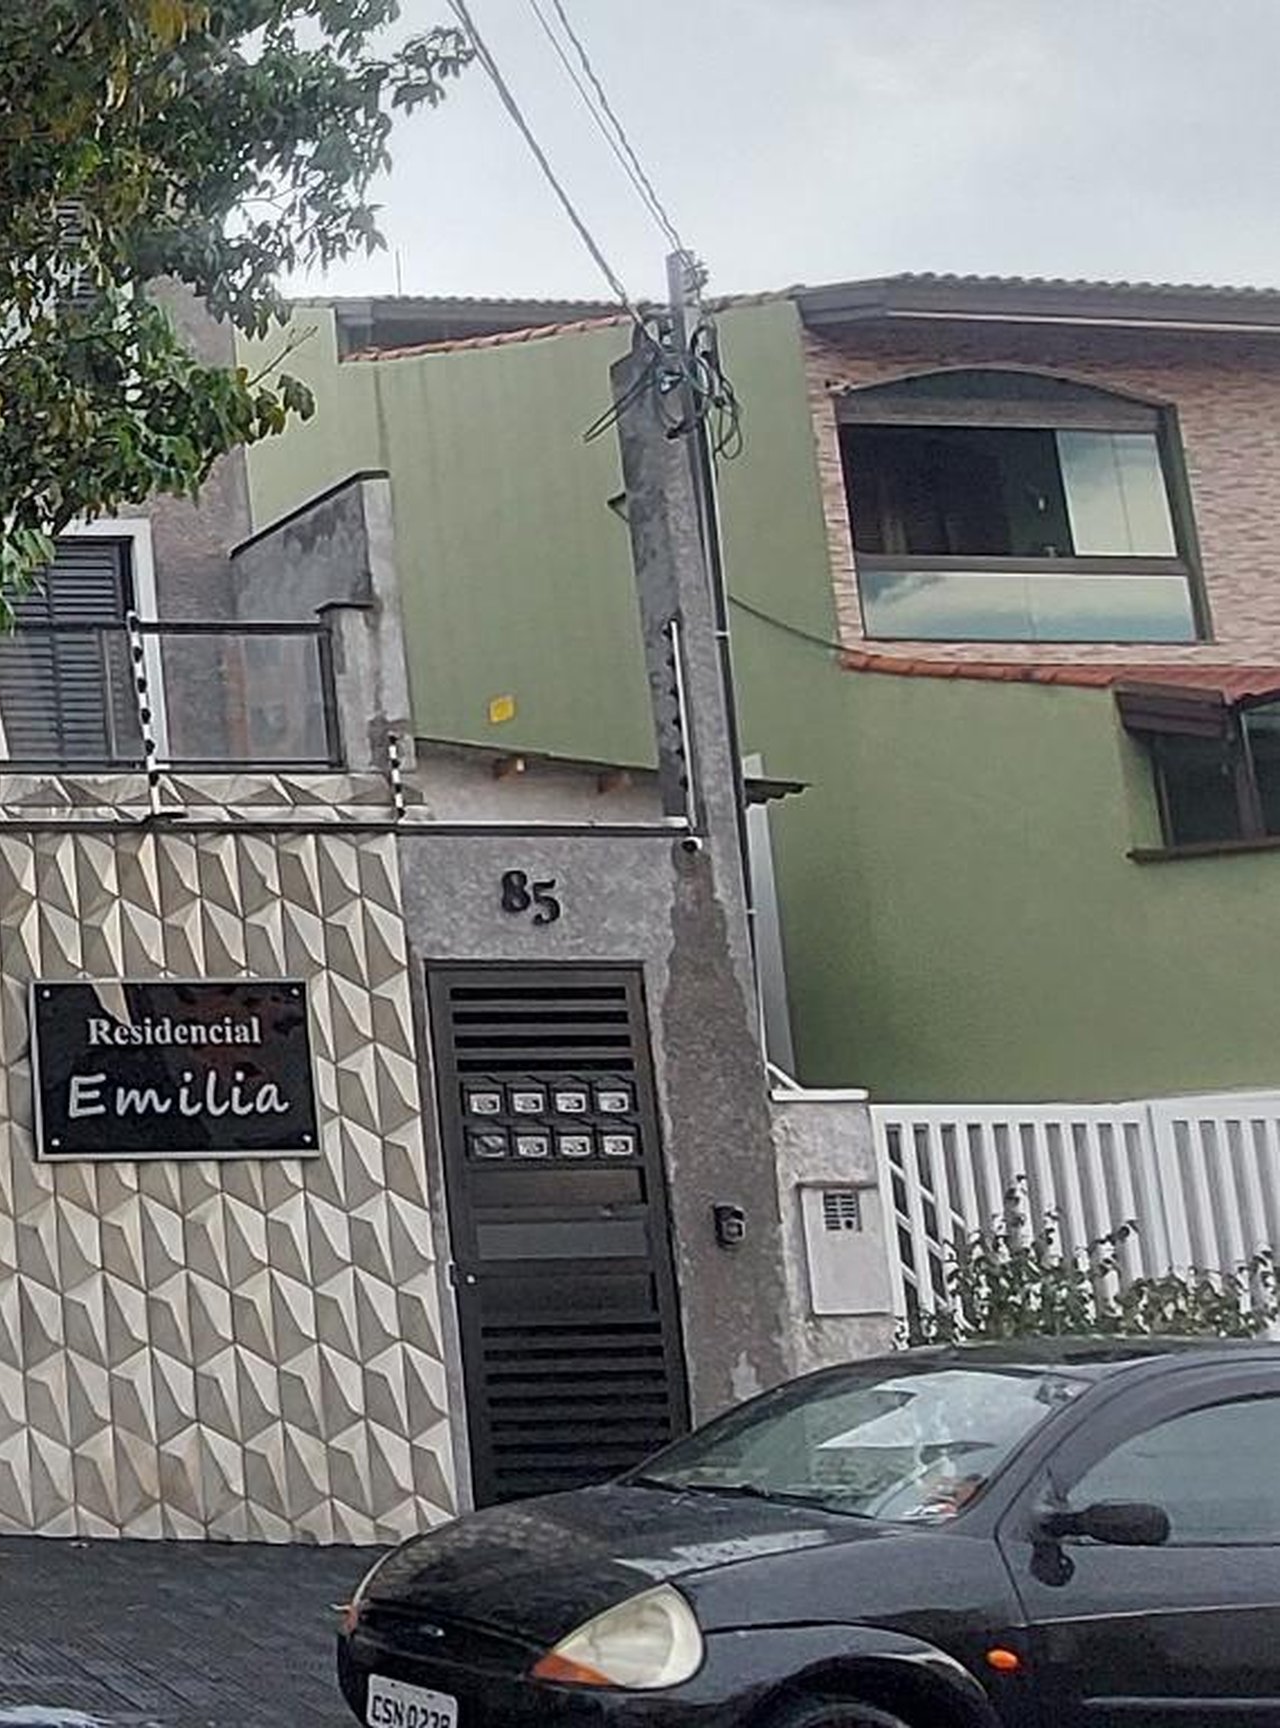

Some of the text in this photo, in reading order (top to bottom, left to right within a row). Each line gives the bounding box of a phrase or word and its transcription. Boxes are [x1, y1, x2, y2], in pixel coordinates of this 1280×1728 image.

[501, 870, 561, 925] 85
[87, 1016, 262, 1045] Residencial
[68, 1070, 290, 1118] Emilia
